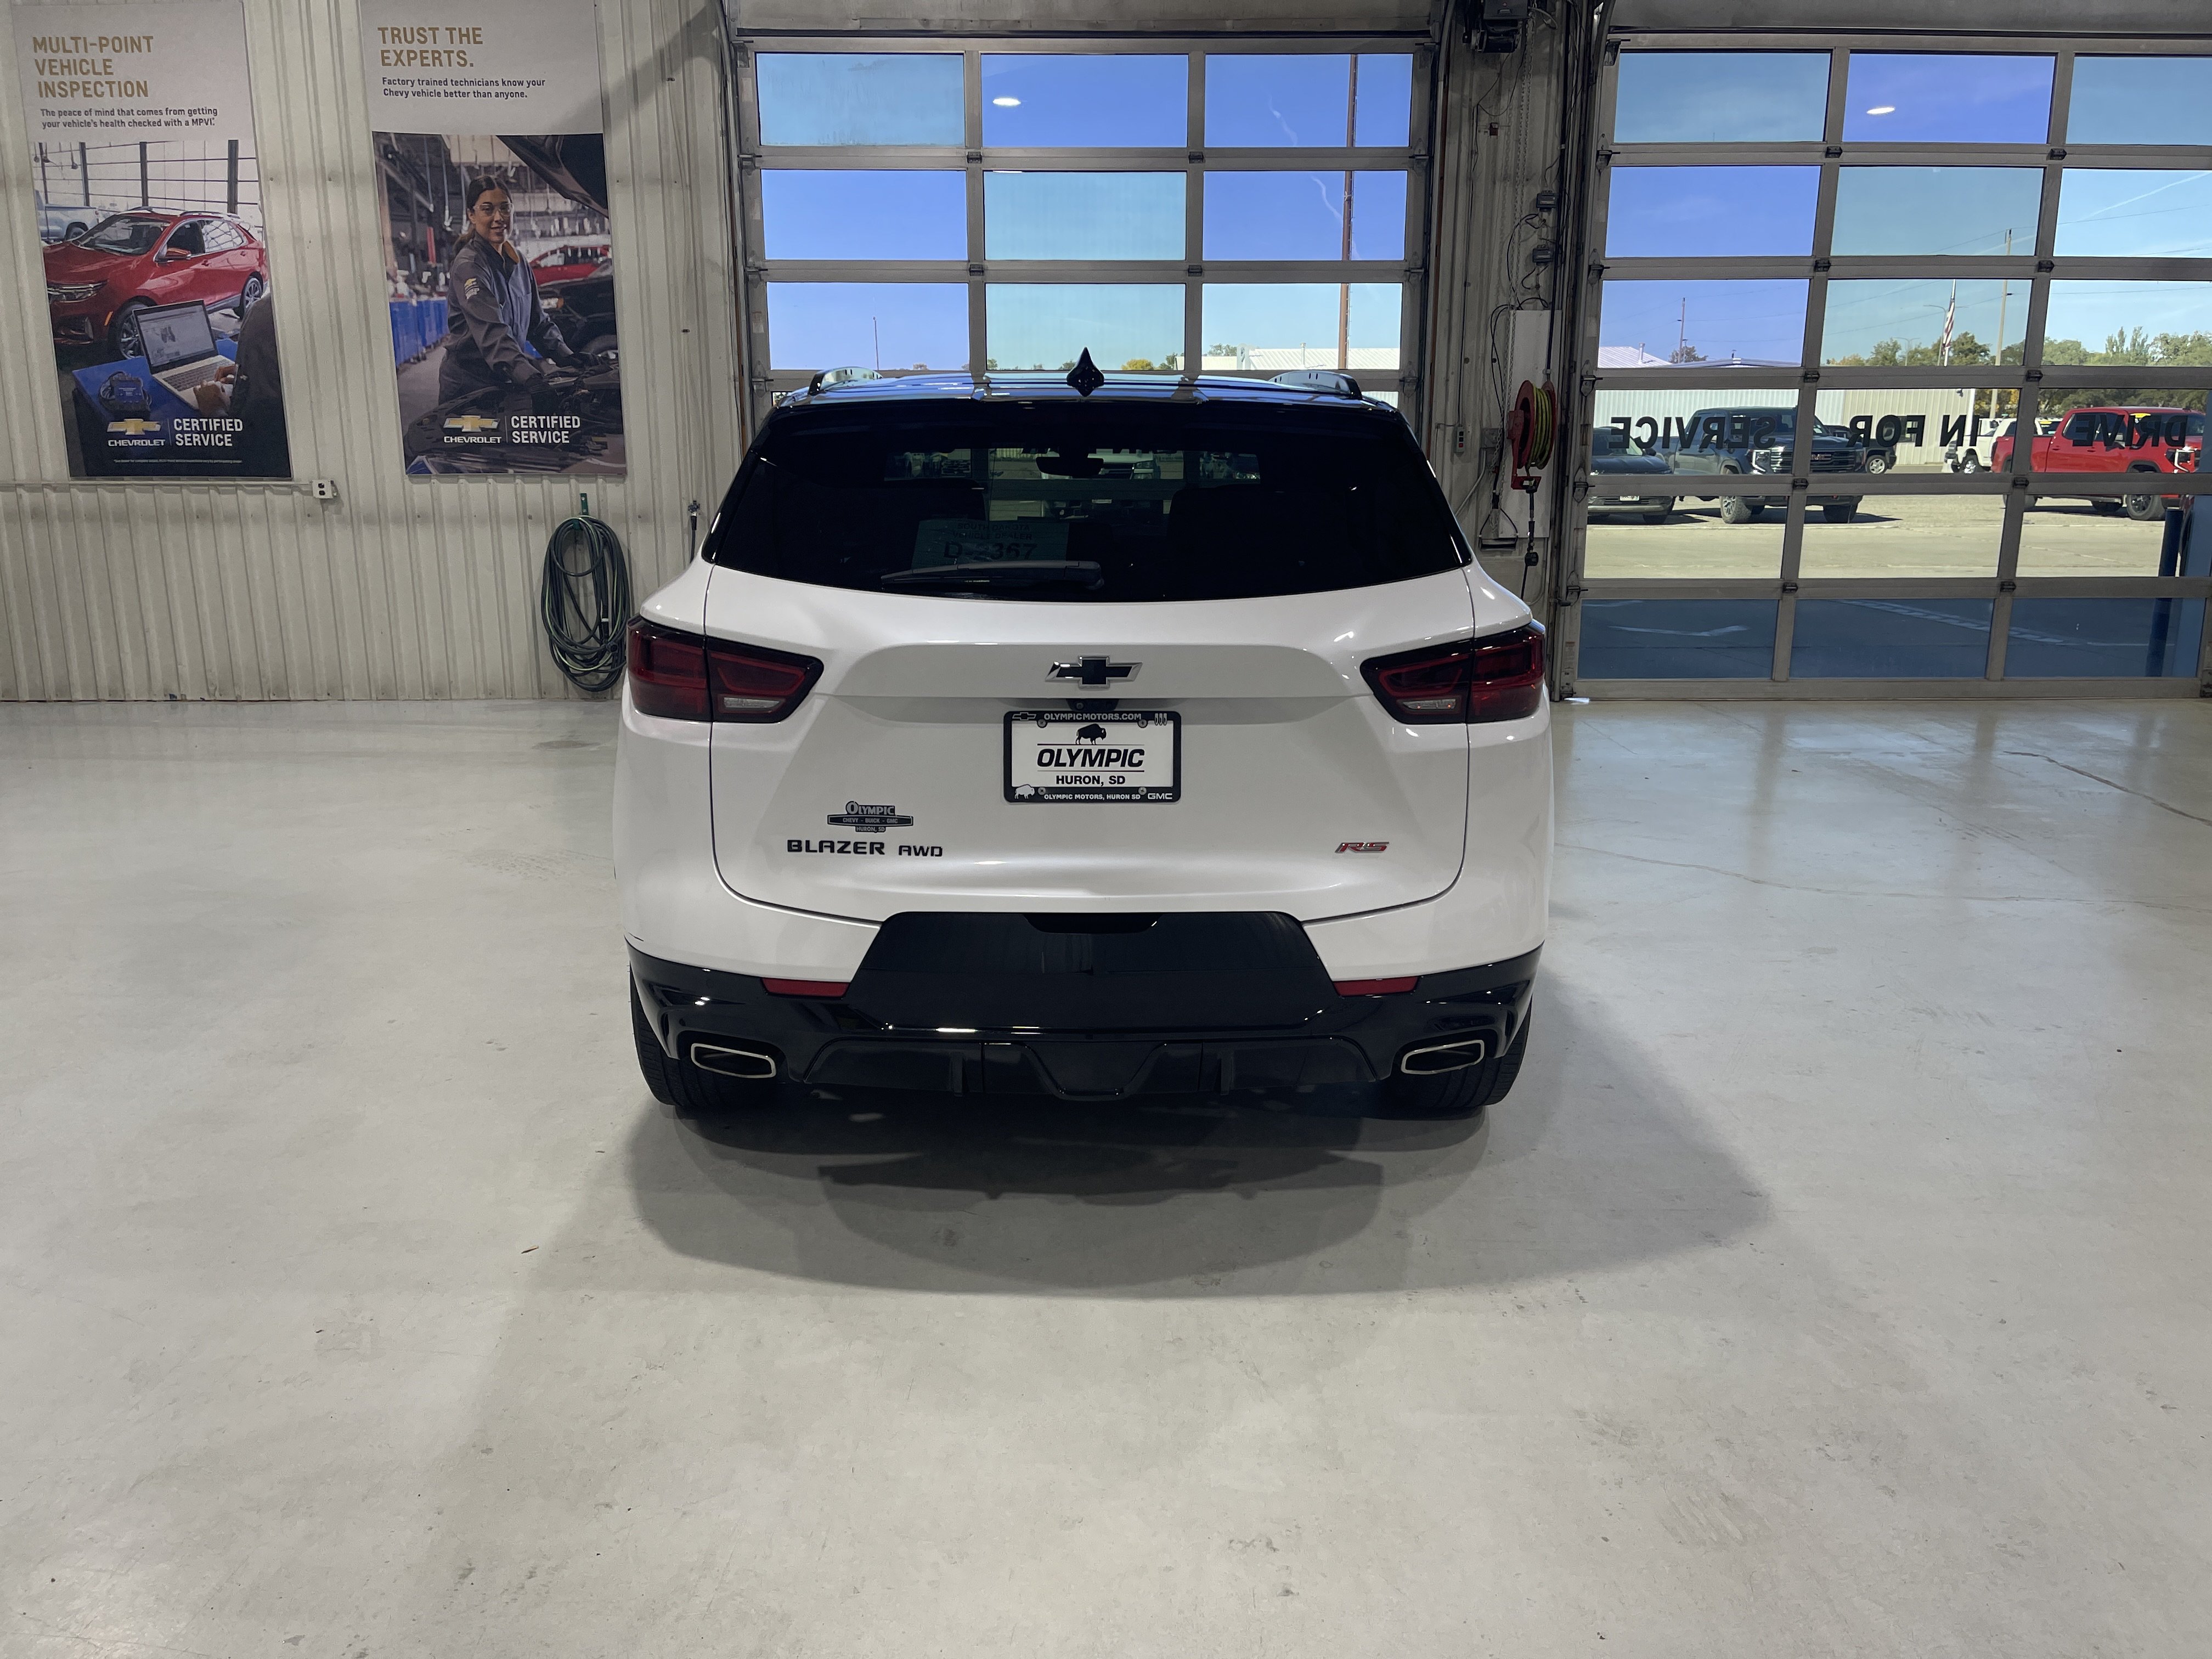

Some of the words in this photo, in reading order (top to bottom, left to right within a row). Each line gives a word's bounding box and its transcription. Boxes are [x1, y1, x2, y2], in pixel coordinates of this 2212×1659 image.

[377, 27, 440, 45] TRUST
[445, 27, 483, 45] THE
[32, 35, 154, 54] MULTI-POINT
[380, 49, 475, 67] EXPERTS.
[35, 58, 114, 76] VEHICLE
[382, 77, 415, 88] Factory
[417, 78, 448, 86] trained
[450, 78, 499, 86] technicians
[526, 80, 545, 88] your
[38, 81, 149, 98] INSPECTION
[383, 88, 409, 99] Chevy
[411, 89, 442, 97] vehicle
[443, 89, 471, 98] better
[494, 91, 528, 100] anyone.
[40, 109, 55, 117] The
[58, 110, 82, 119] peace
[84, 108, 93, 116] of
[95, 108, 115, 116] mind
[117, 108, 134, 116] that
[165, 108, 185, 116] from
[188, 107, 218, 117] getting
[42, 121, 60, 130] your
[63, 119, 98, 128] vehicle's
[99, 119, 126, 128] health
[128, 119, 162, 127] checked
[164, 118, 182, 127] with
[173, 418, 244, 432] CERTIFIED
[511, 415, 581, 429] CERTIFIED
[108, 439, 166, 447] CHEVROLET
[175, 433, 233, 447] SERVICE
[512, 431, 570, 444] SERVICE
[957, 522, 989, 531] SOUTH
[952, 532, 992, 540] VEHICLE
[995, 532, 1032, 540] DEALER
[1037, 748, 1145, 768] OLYMPIC
[1056, 775, 1104, 787] HURON,
[1109, 775, 1126, 785] SD
[846, 802, 895, 815] OLYMPIC
[787, 839, 885, 855] BLAZER
[899, 845, 943, 857] AWD
[1334, 841, 1389, 854] RS
